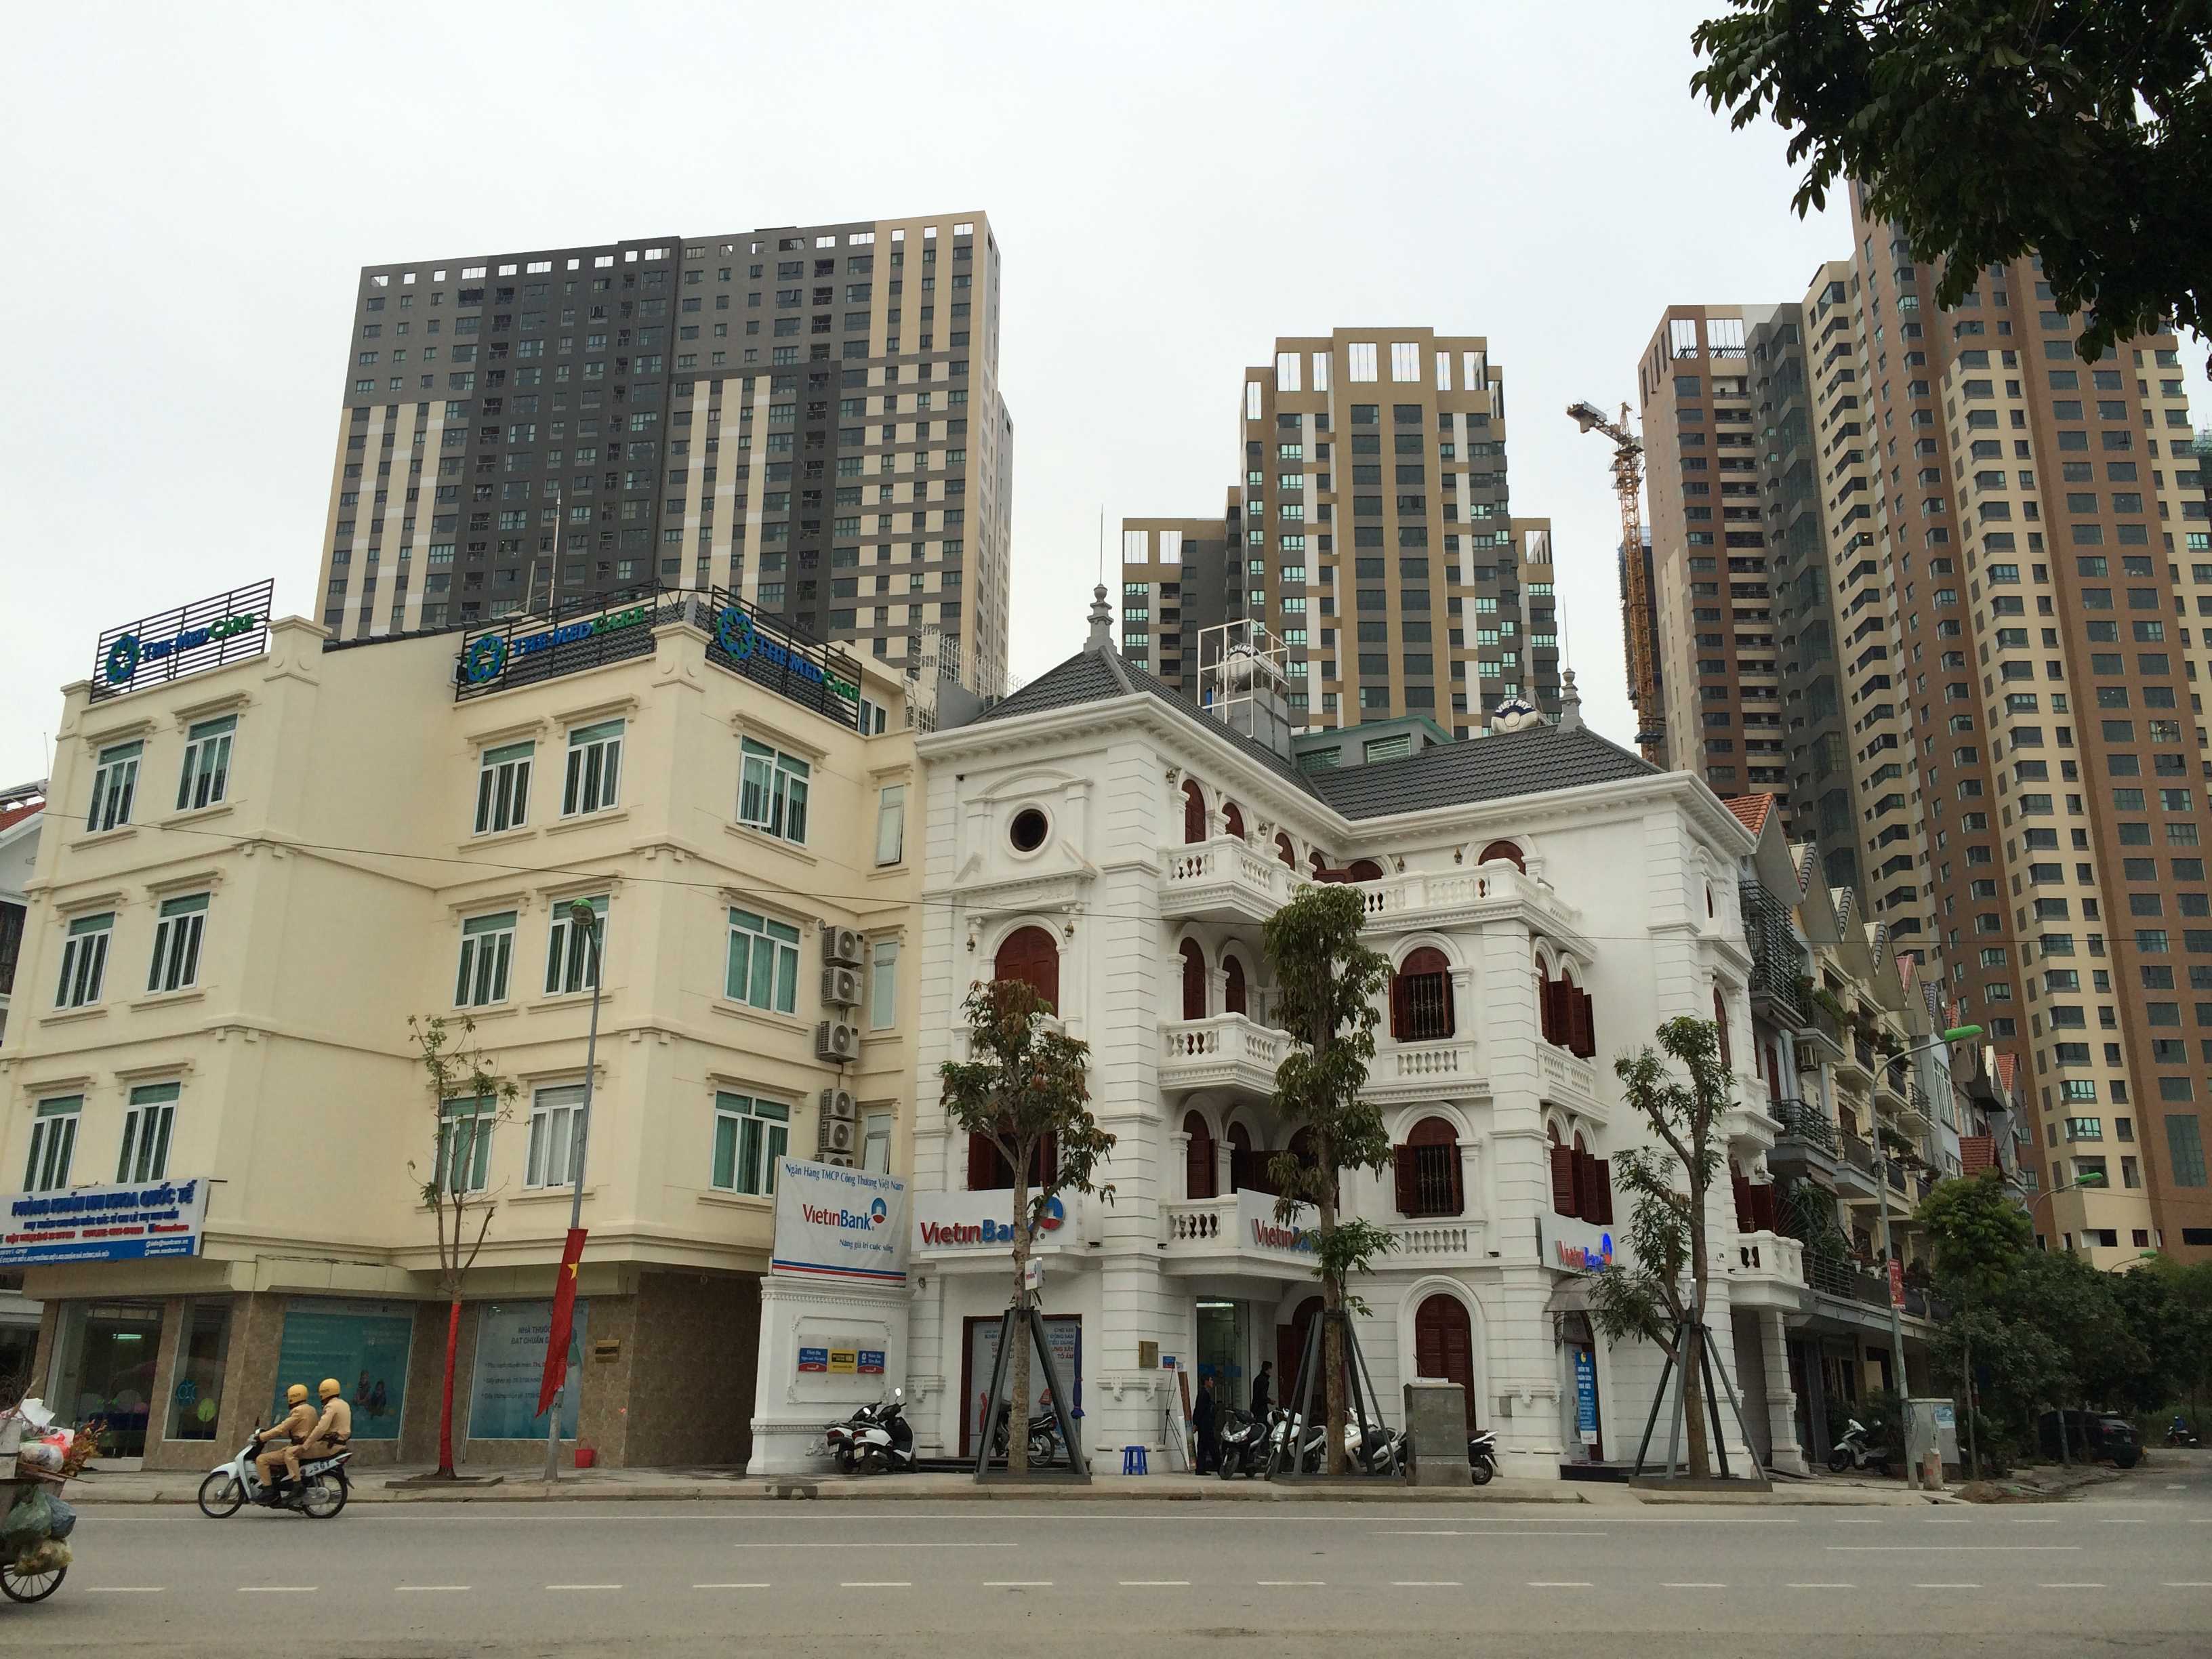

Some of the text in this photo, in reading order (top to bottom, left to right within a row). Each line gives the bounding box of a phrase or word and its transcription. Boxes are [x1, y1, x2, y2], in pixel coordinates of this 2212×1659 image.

[513, 631, 548, 657] THE
[756, 635, 787, 665] THE
[821, 1169, 839, 1181] TMCP
[890, 1180, 904, 1191] Nam
[802, 1204, 872, 1231] VietinBank
[920, 1218, 1017, 1245] VietinBa
